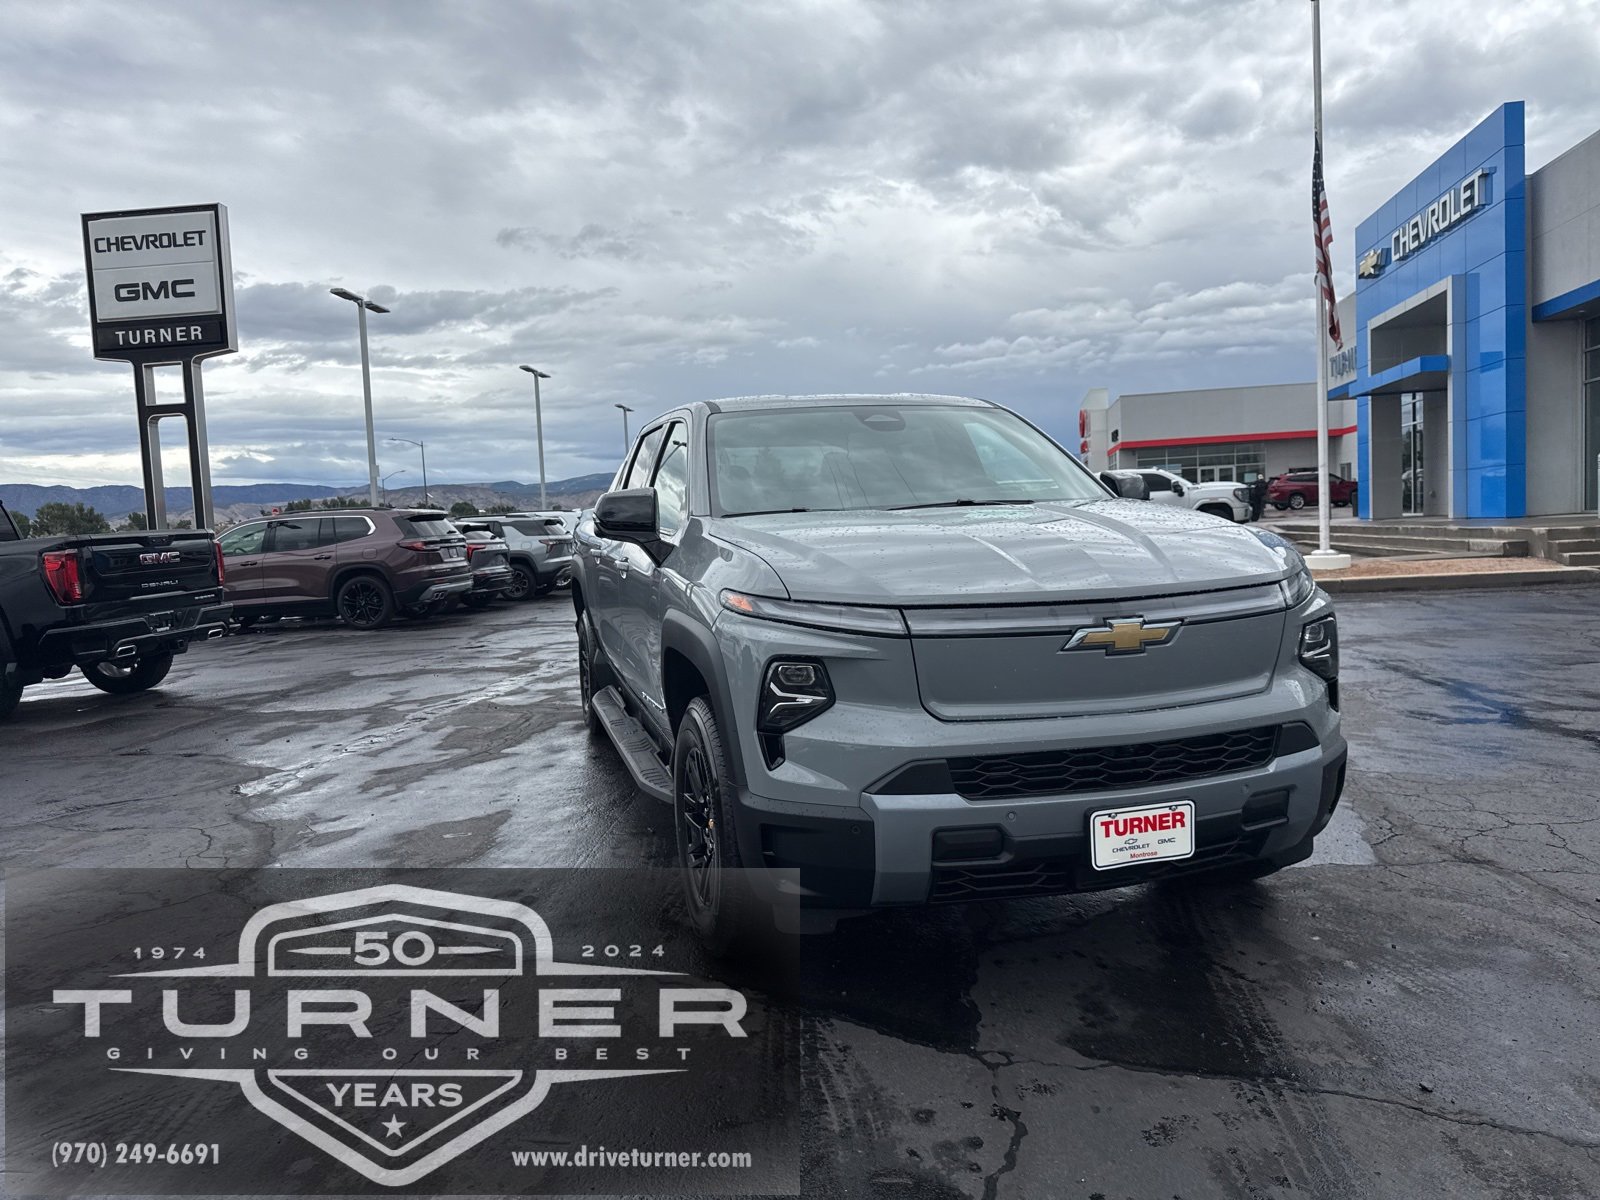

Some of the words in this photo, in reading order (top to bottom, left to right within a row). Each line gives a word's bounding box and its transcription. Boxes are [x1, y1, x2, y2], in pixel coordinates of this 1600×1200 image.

[1391, 167, 1488, 262] CHEVROLET
[94, 230, 206, 253] CHEVROLET
[114, 278, 195, 302] GMC
[115, 325, 203, 345] TURNER
[140, 551, 180, 565] GMC
[141, 580, 178, 588] DENALI
[1100, 811, 1185, 838] TURNER
[1112, 843, 1150, 853] CHEVROLET
[1157, 837, 1176, 845] GMC
[1129, 850, 1158, 859] Montrose
